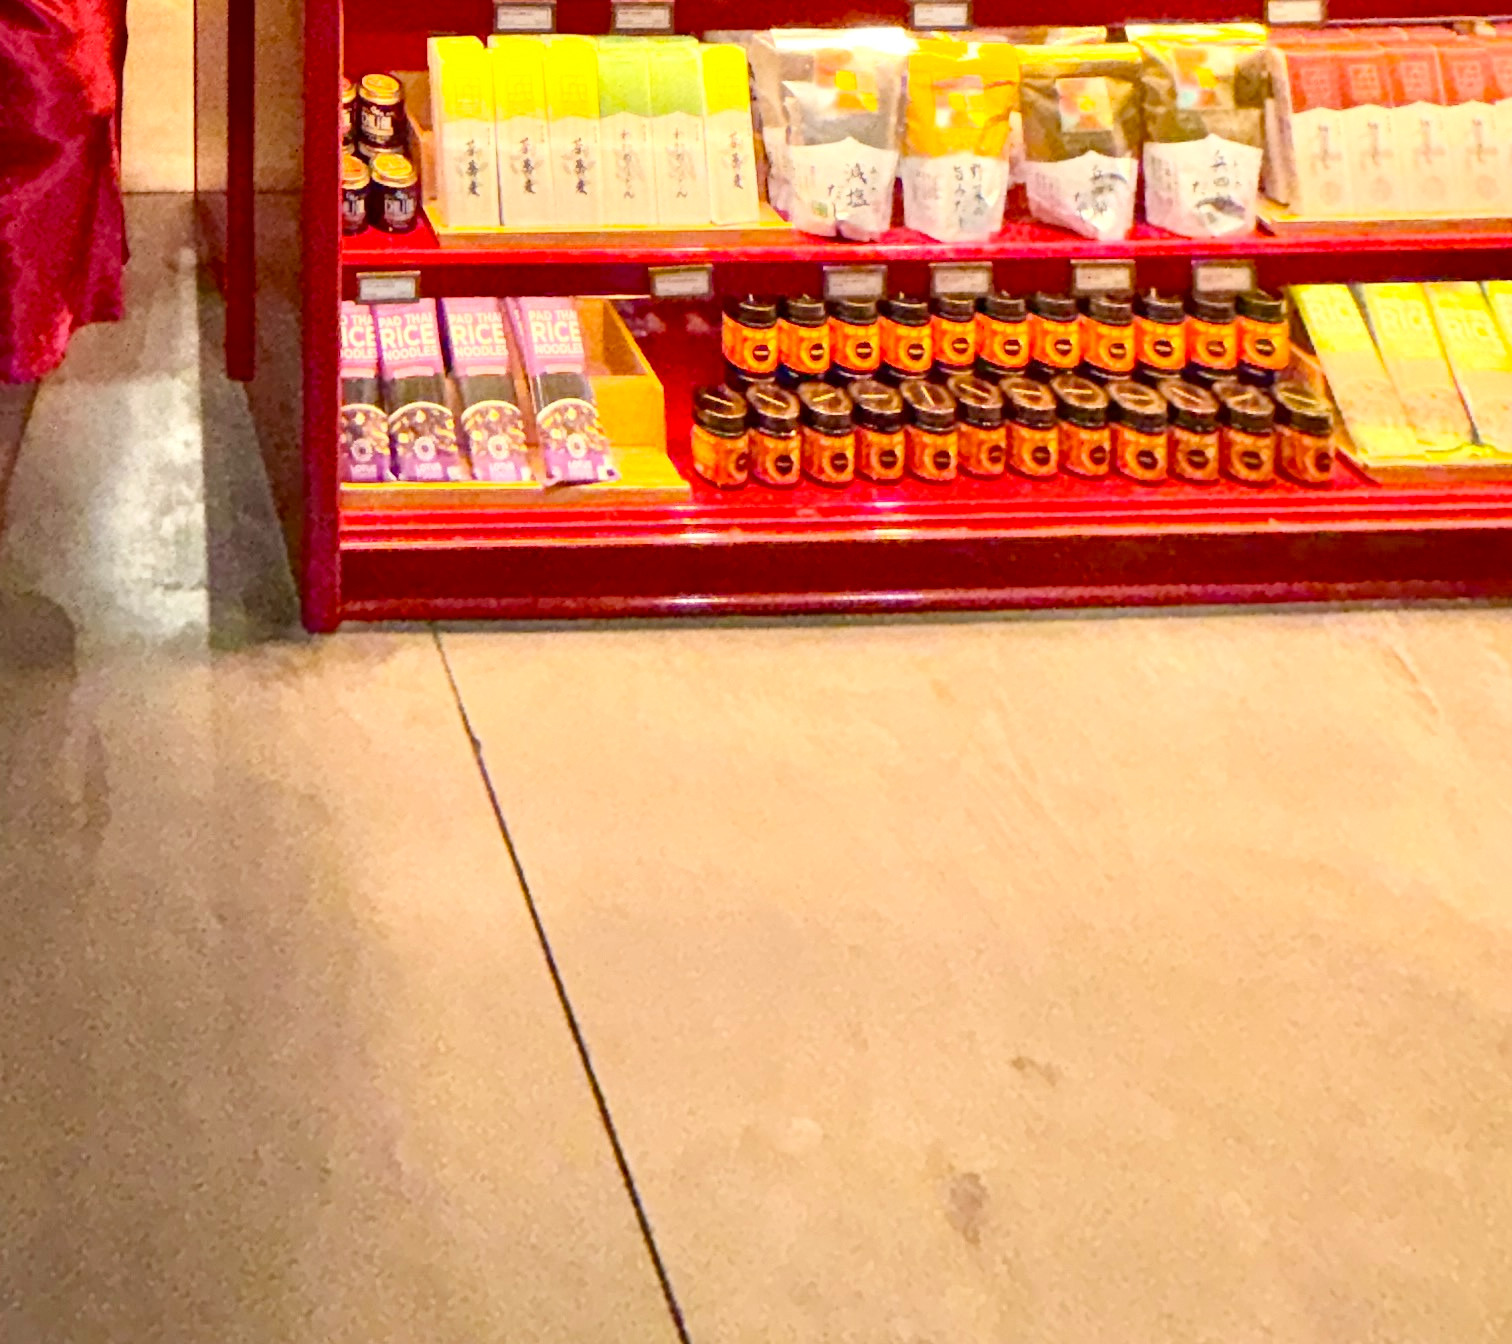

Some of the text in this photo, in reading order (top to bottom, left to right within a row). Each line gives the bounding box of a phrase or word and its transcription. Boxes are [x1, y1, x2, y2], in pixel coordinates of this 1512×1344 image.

[340, 326, 376, 347] ICE
[379, 324, 436, 349] RICE
[450, 323, 506, 345] RICE
[530, 320, 582, 343] RICE
